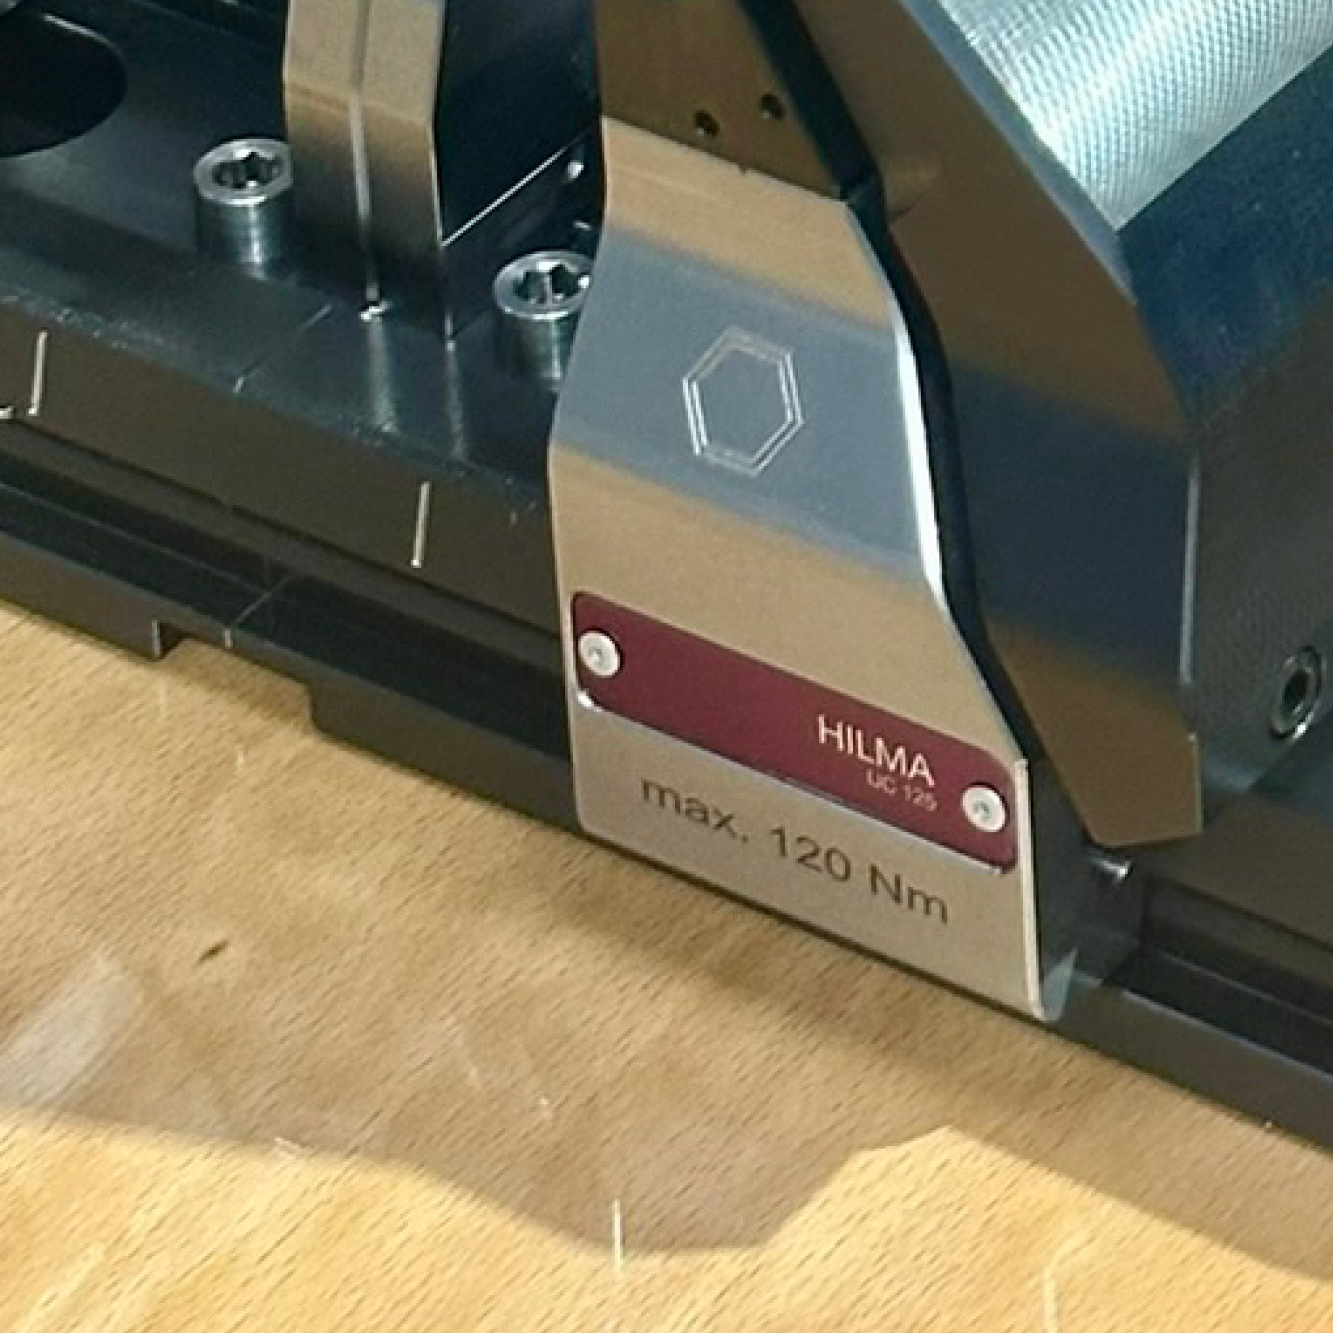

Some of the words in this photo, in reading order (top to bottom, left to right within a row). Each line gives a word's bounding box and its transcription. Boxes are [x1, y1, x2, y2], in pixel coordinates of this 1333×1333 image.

[817, 713, 937, 787] HILMA
[641, 777, 749, 844] max.
[769, 825, 853, 884] 120
[870, 861, 949, 925] Nm
